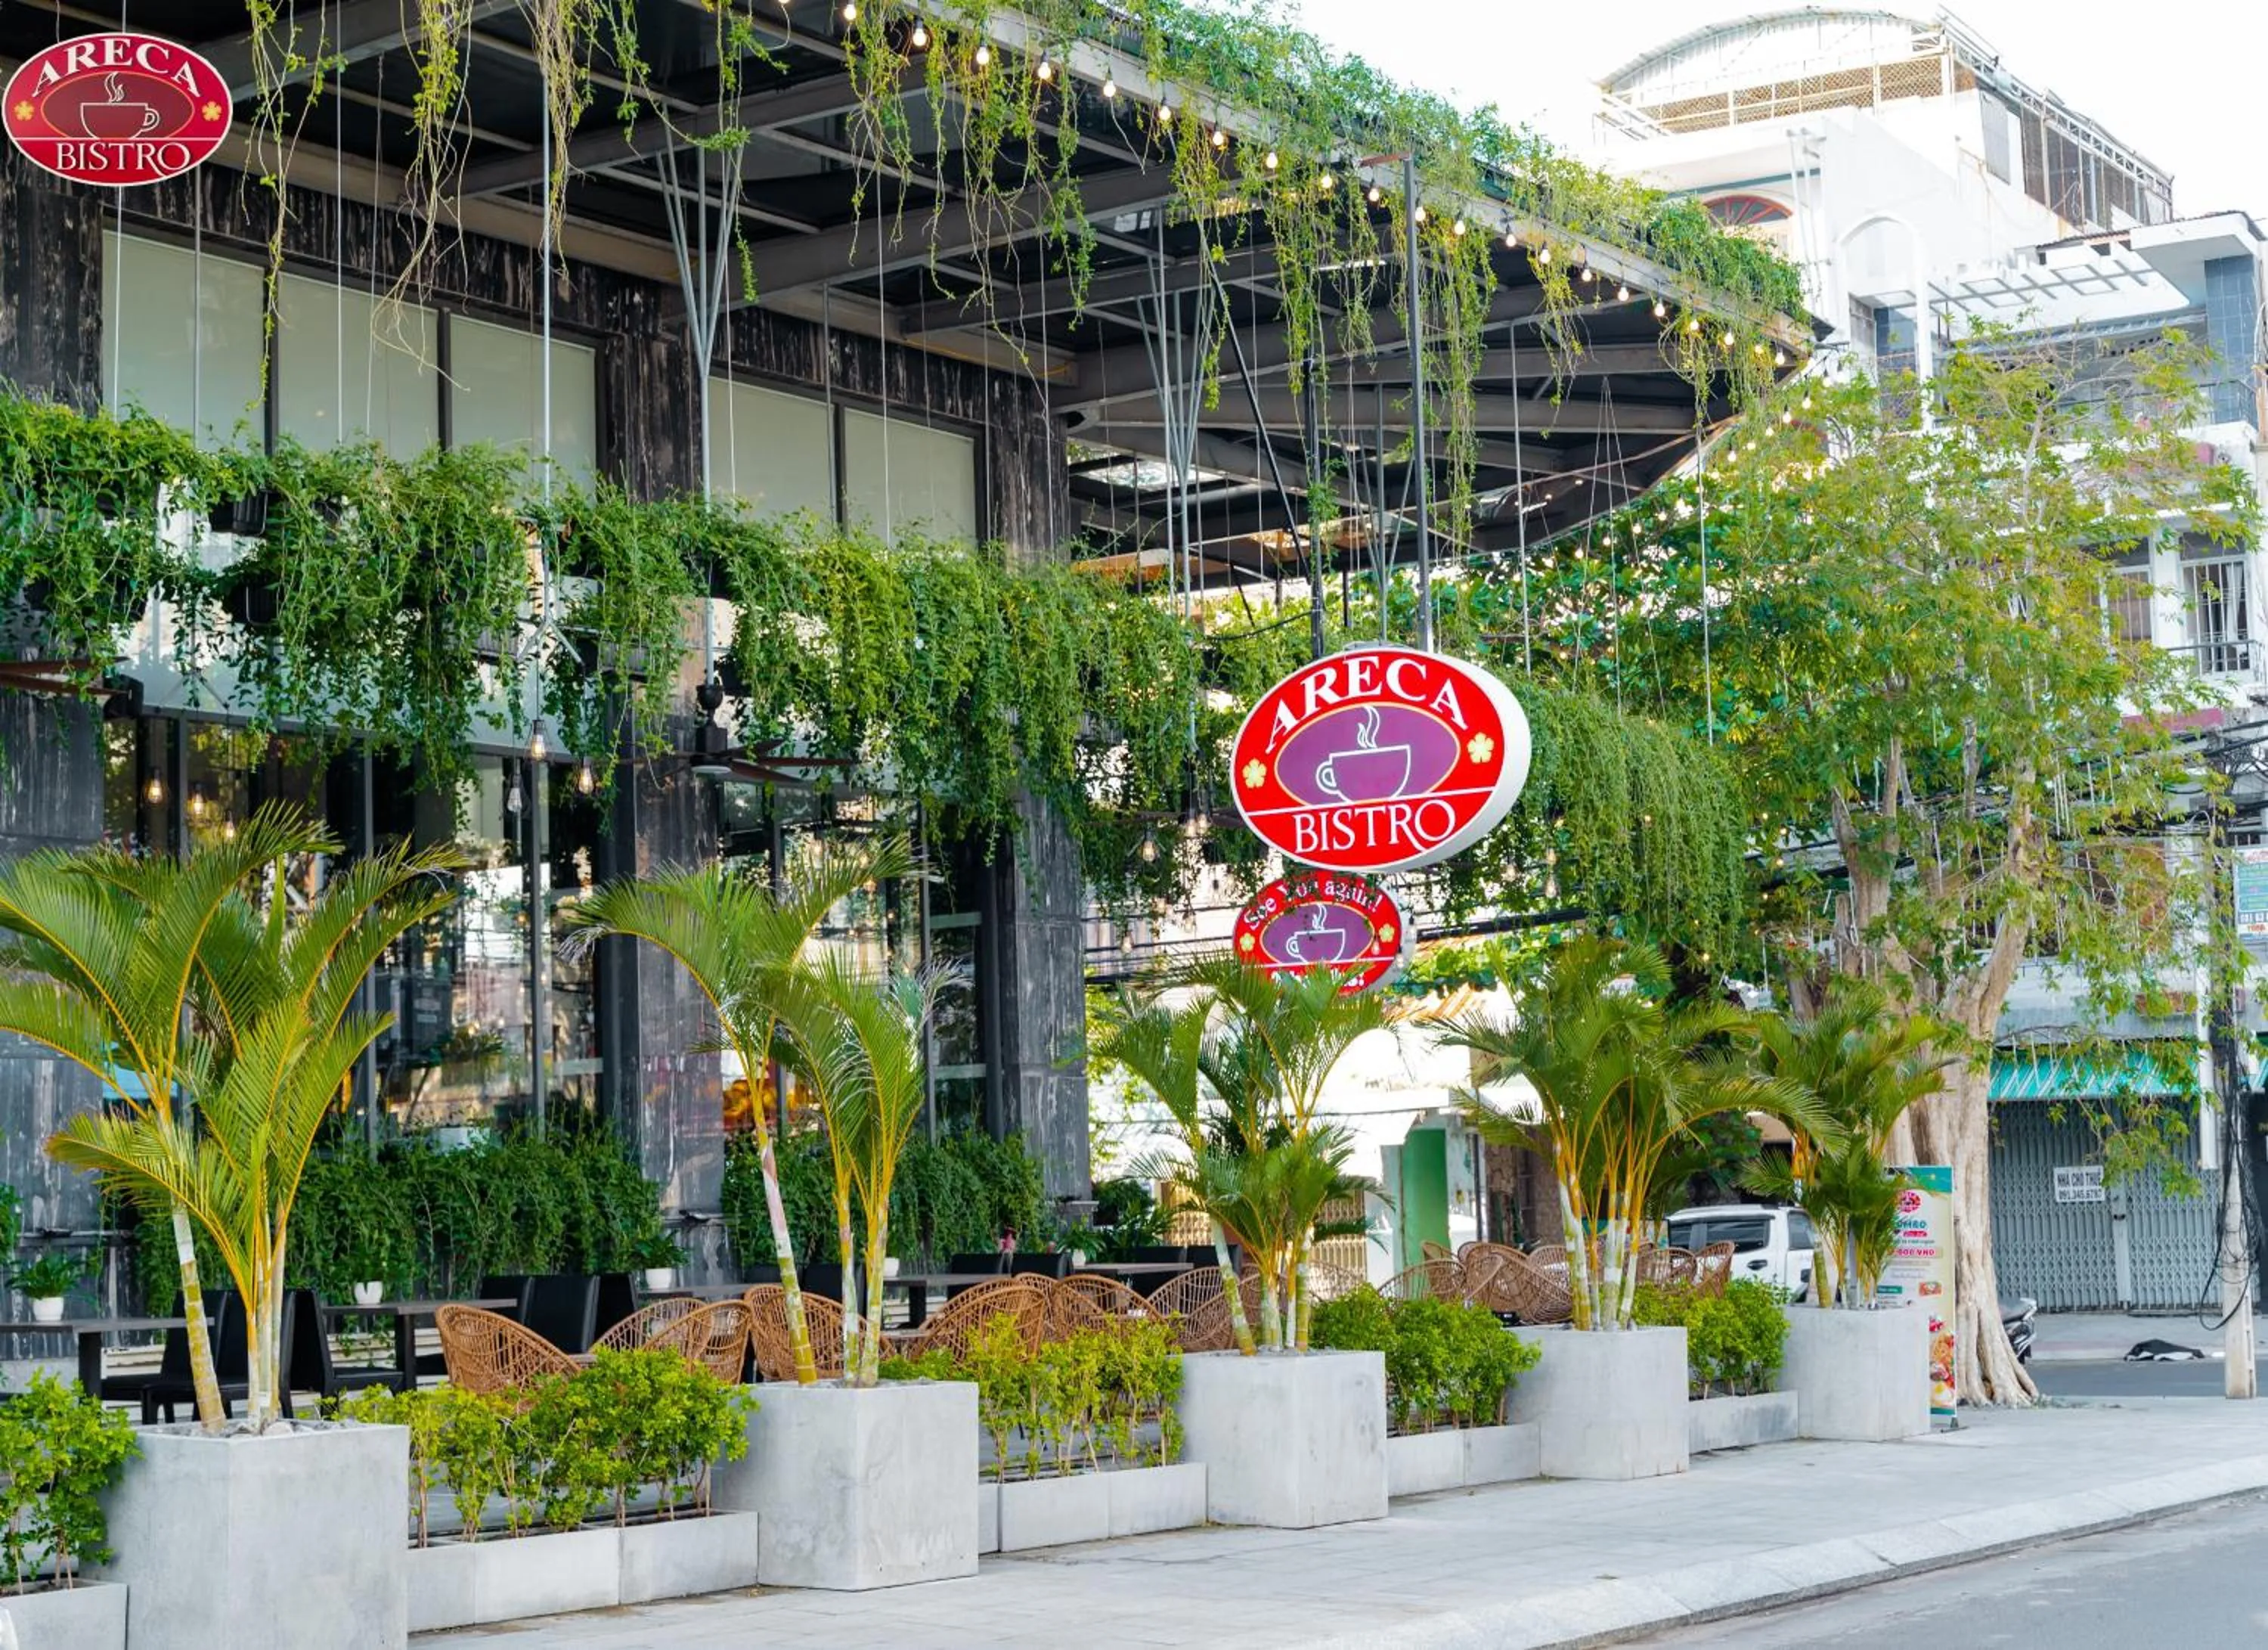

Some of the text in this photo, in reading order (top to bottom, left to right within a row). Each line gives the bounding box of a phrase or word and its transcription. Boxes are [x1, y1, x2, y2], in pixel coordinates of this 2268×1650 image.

[1265, 656, 1468, 755] ARECA
[1290, 799, 1456, 854] BISTRO
[1895, 1219, 1928, 1230] OMBO
